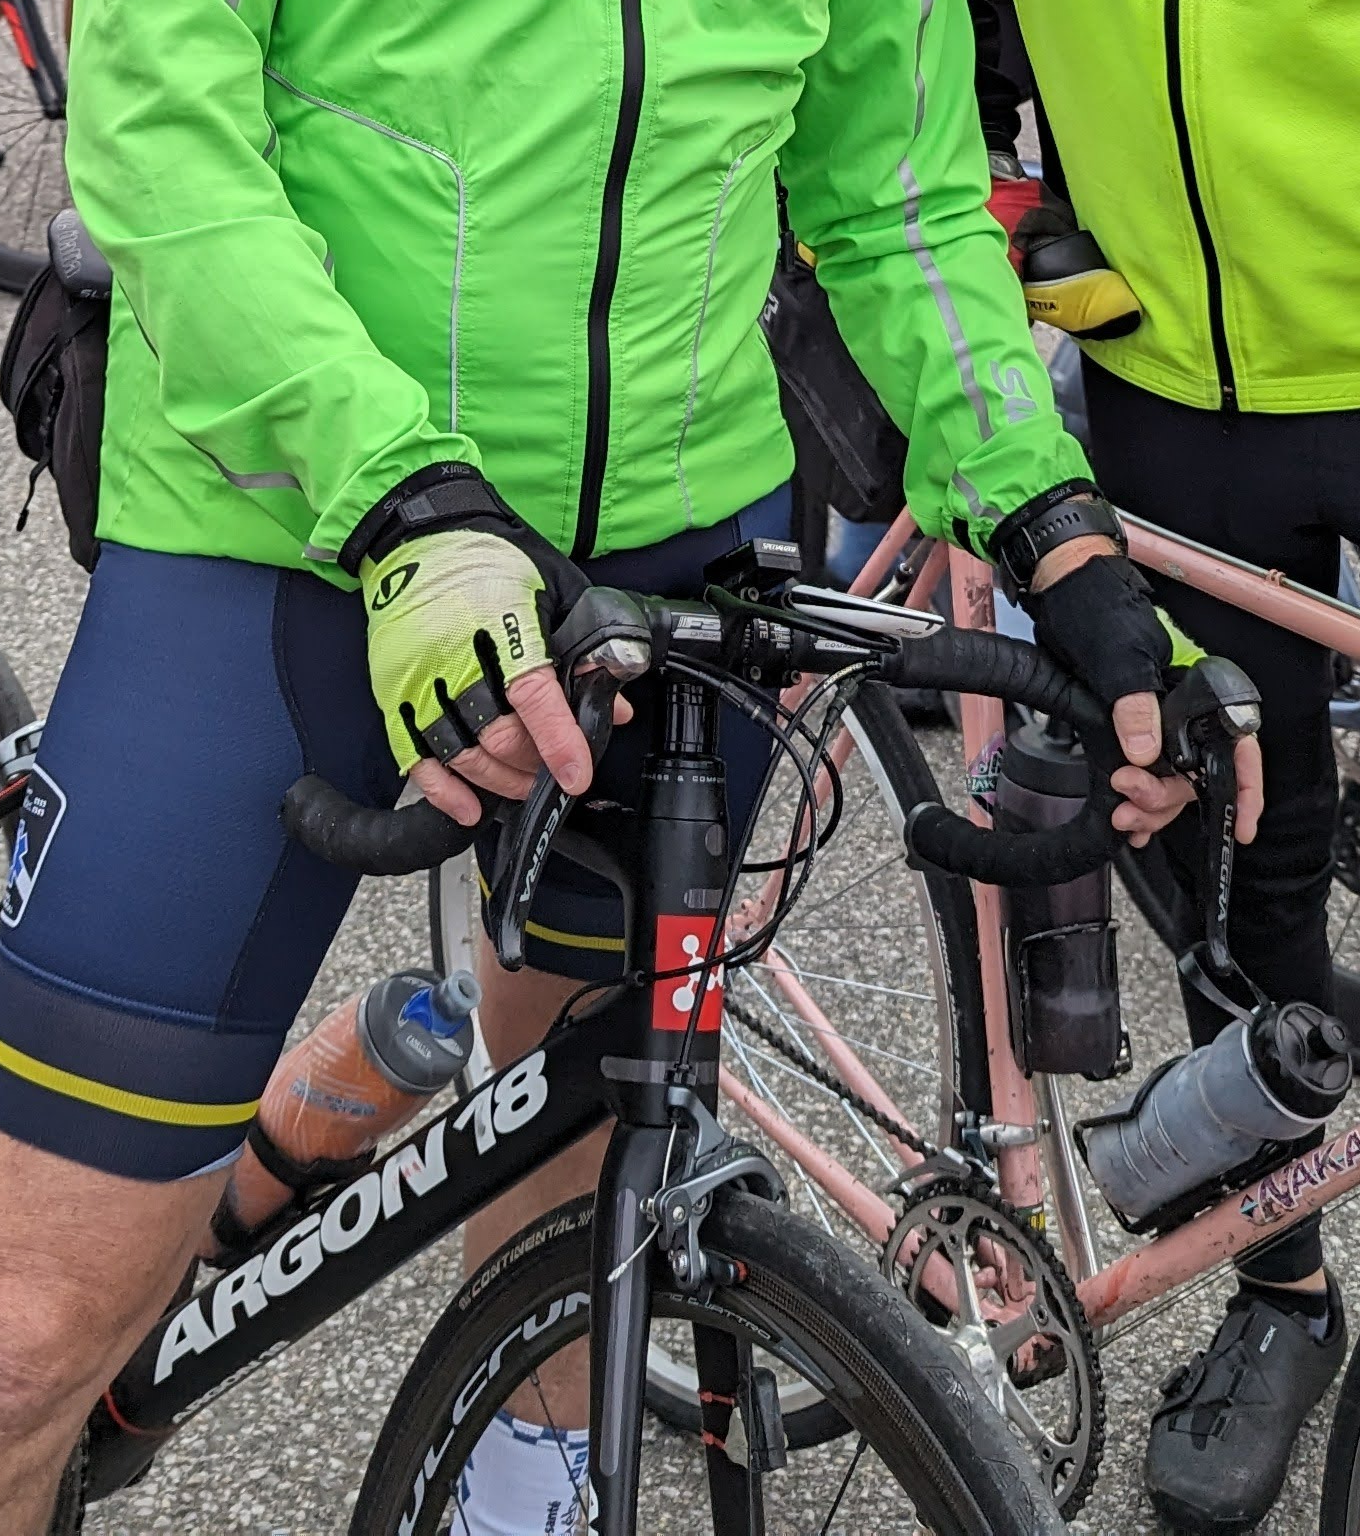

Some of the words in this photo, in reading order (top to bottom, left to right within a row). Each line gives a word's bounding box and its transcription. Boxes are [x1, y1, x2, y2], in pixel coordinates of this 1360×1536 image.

[518, 792, 571, 903] TEGRA
[1217, 803, 1234, 922] ULTEGRA
[152, 1116, 450, 1386] ARGON
[452, 1048, 550, 1156] 18
[471, 1213, 577, 1300] CONTINENTAL
